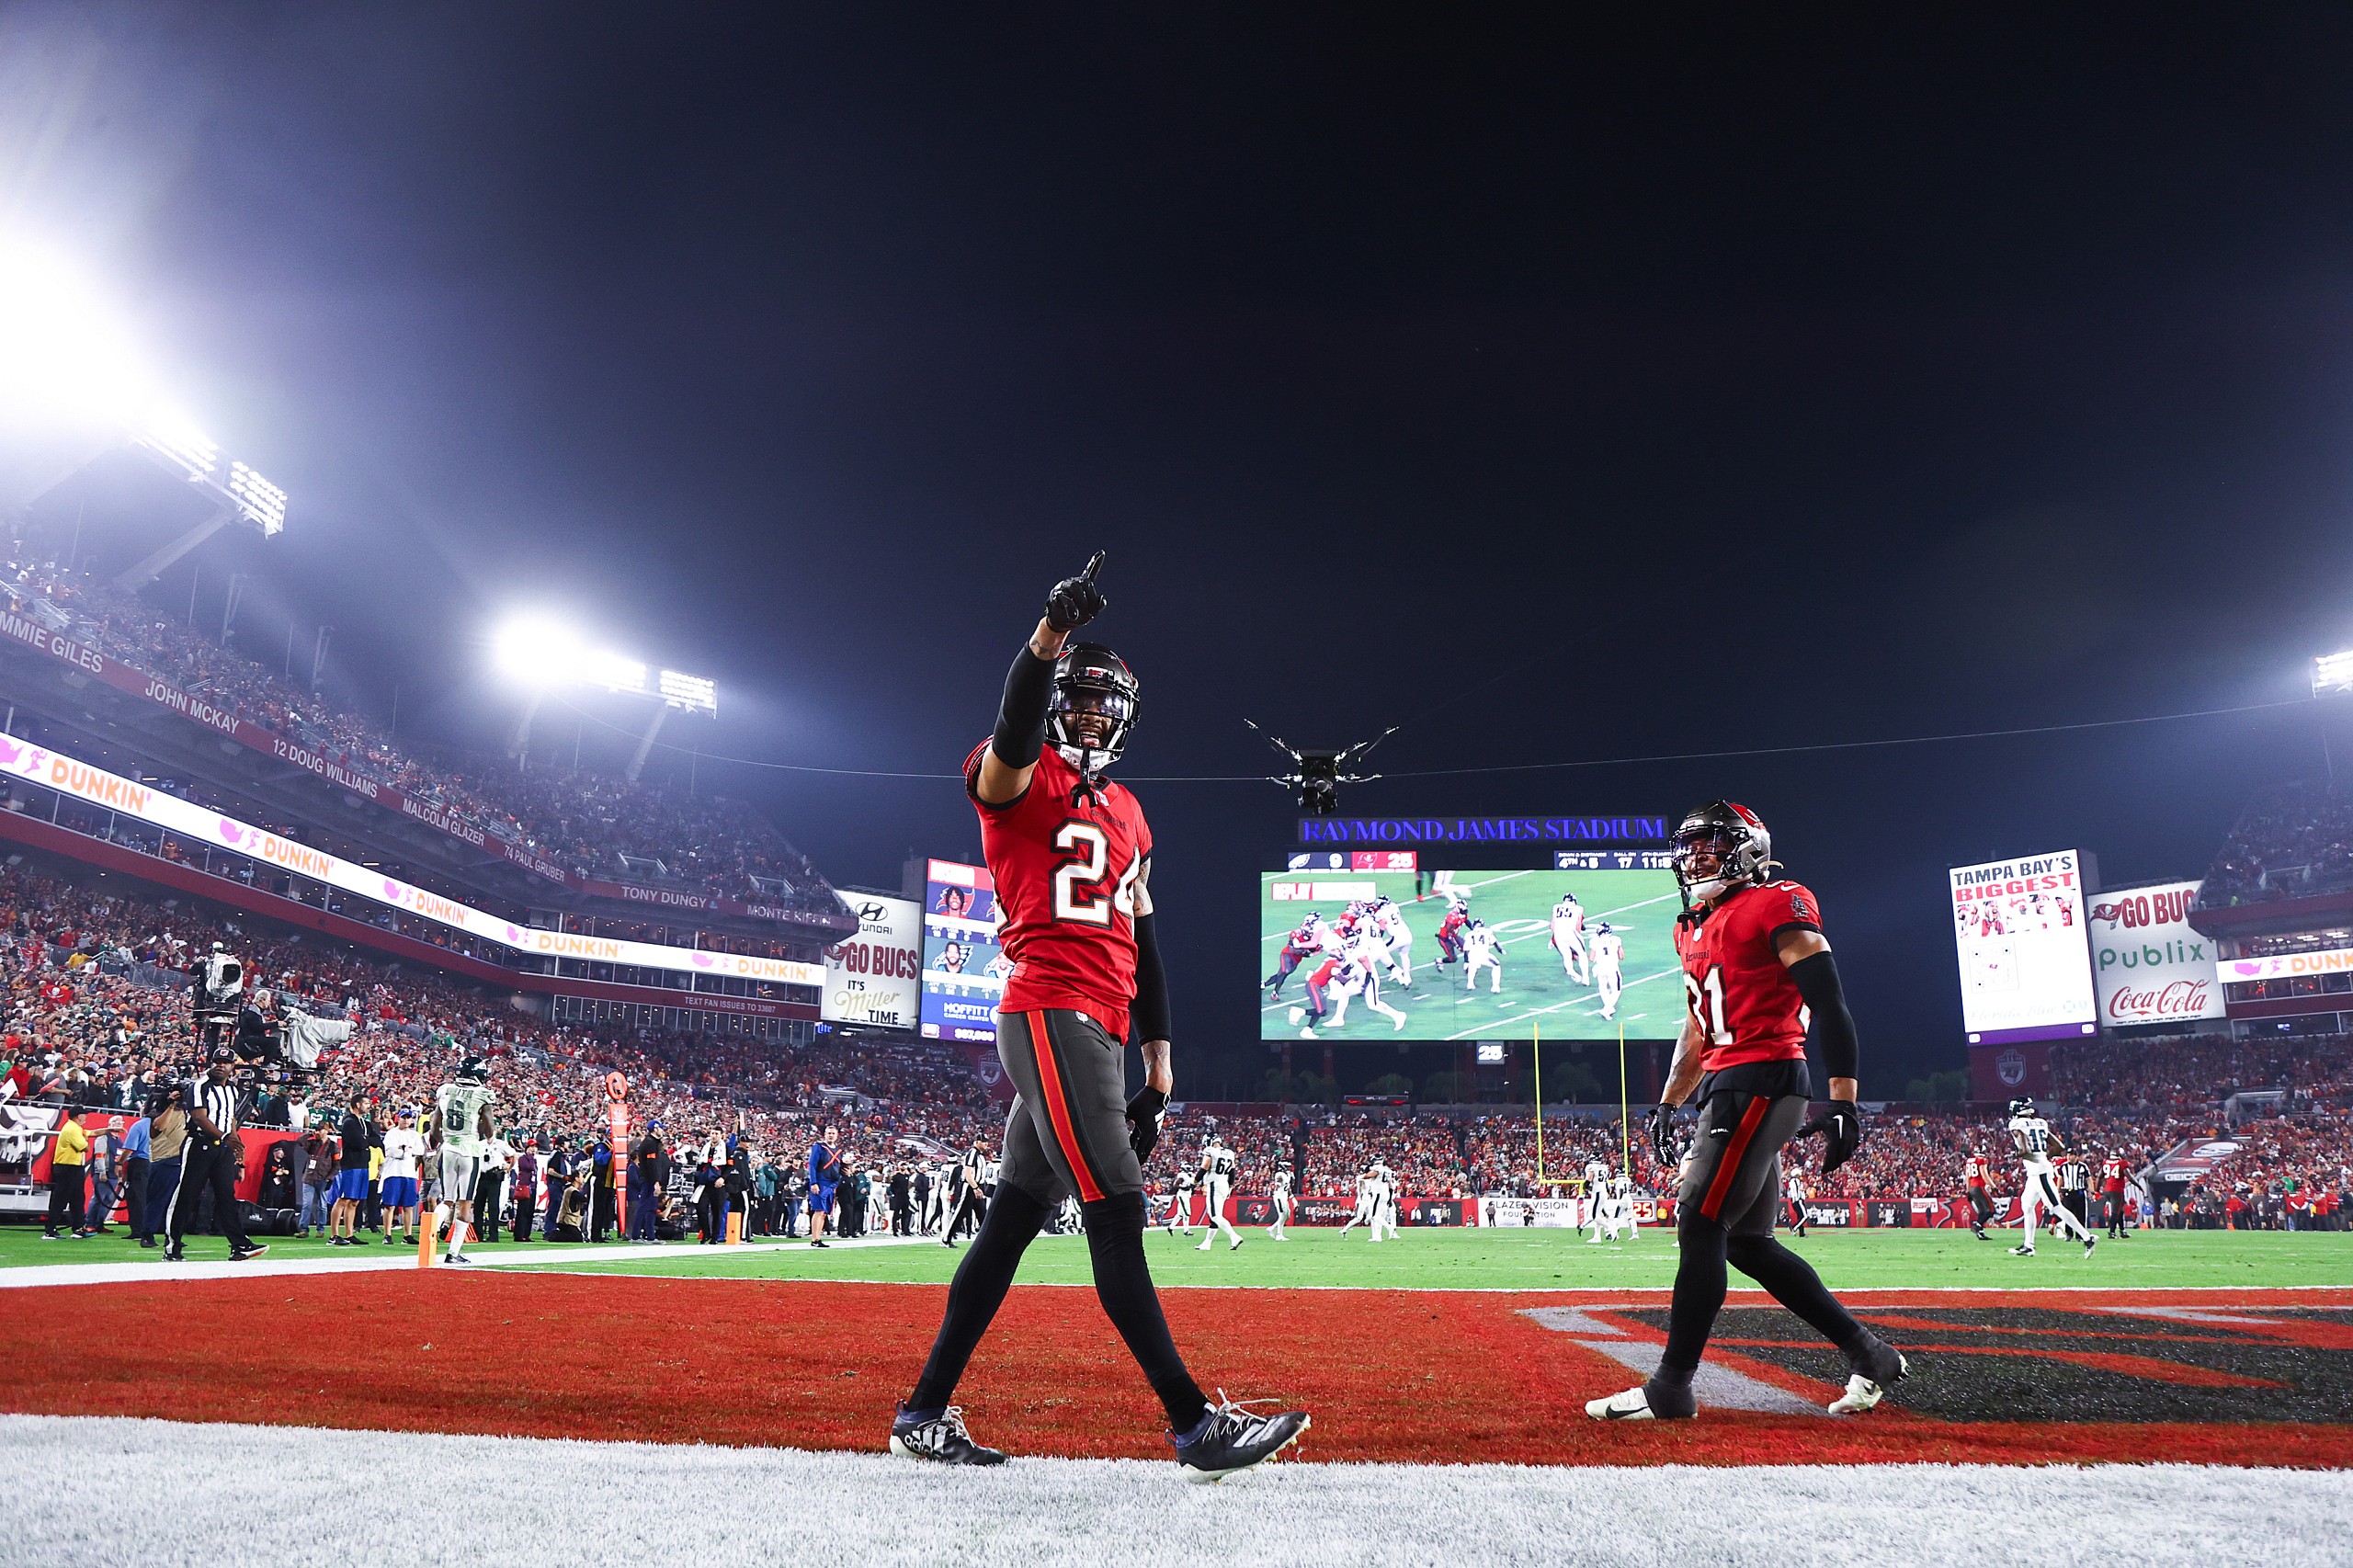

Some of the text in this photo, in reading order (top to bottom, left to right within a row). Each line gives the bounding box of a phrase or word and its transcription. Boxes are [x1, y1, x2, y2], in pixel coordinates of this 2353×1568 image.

[51, 636, 103, 673] GILES
[145, 680, 239, 733] JOHN MCKAY
[274, 739, 378, 799] 12 DOUG WILLIAMS
[51, 758, 152, 812] DUNKIN'
[403, 798, 484, 846] MALCOLM GLAZER
[1302, 818, 1665, 841] RAYMOND JAMES STADIUM
[264, 836, 335, 877] DUNKIN'
[505, 845, 564, 882] 74 PAUL GRUBER
[1329, 853, 1343, 869] 9
[1388, 853, 1413, 868] 25
[1559, 857, 1578, 869] 4TH
[1618, 857, 1632, 869] 17
[1642, 857, 1672, 869] 11:5
[1954, 856, 2072, 886] TAMPA BAY'S
[622, 886, 707, 908] TONY DUNGY
[1956, 872, 2075, 903] BIGGEST
[416, 892, 469, 925] DUNKIN'
[747, 904, 790, 921] MONTE
[2121, 889, 2195, 928] GO BUC
[858, 923, 892, 935] UNDAI
[539, 934, 624, 958] DUNKIN'
[2099, 939, 2205, 971] Publix
[737, 960, 812, 981] DUNKIN'
[847, 942, 870, 973] GO
[872, 946, 917, 980] BUCS
[847, 980, 865, 991] IT'S
[685, 996, 702, 1006] TEXT
[704, 998, 718, 1007] FAN
[720, 1001, 745, 1010] ISSUES
[835, 991, 901, 1017] Miller
[2109, 979, 2211, 1018] Coca-Cola
[868, 1009, 899, 1025] TIME
[944, 1003, 990, 1017] MOFFITT
[1478, 1045, 1503, 1061] 25
[447, 1098, 465, 1131] 6
[1215, 1157, 1233, 1175] 62
[2103, 1164, 2120, 1179] 94
[1532, 1200, 1569, 1210] VISION
[1632, 1202, 1653, 1218] 25
